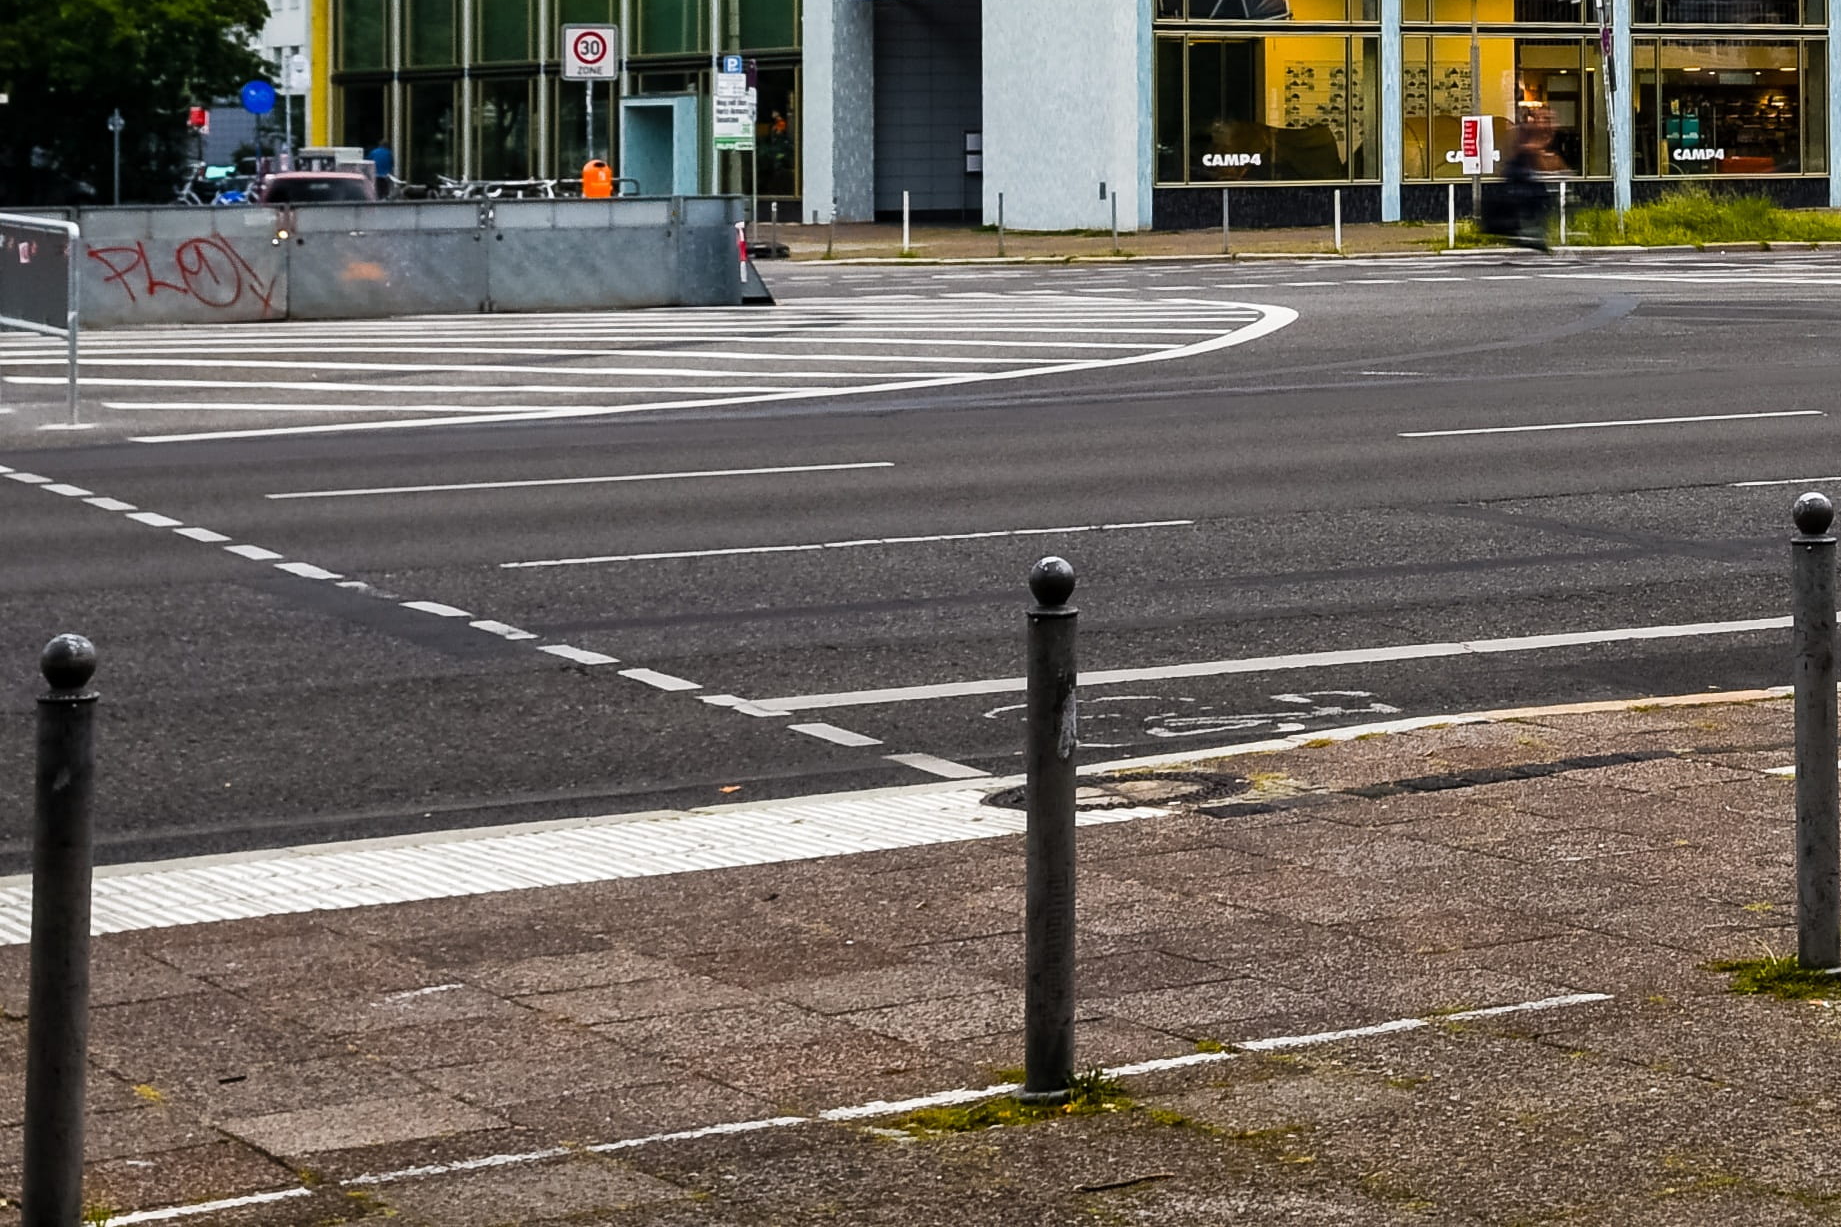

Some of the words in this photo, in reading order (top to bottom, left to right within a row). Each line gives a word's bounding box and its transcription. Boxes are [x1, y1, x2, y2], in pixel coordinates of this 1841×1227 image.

[580, 40, 600, 56] 30
[577, 66, 603, 75] ZONE
[1202, 153, 1261, 167] CAMP4
[1673, 148, 1724, 161] CAMP4
